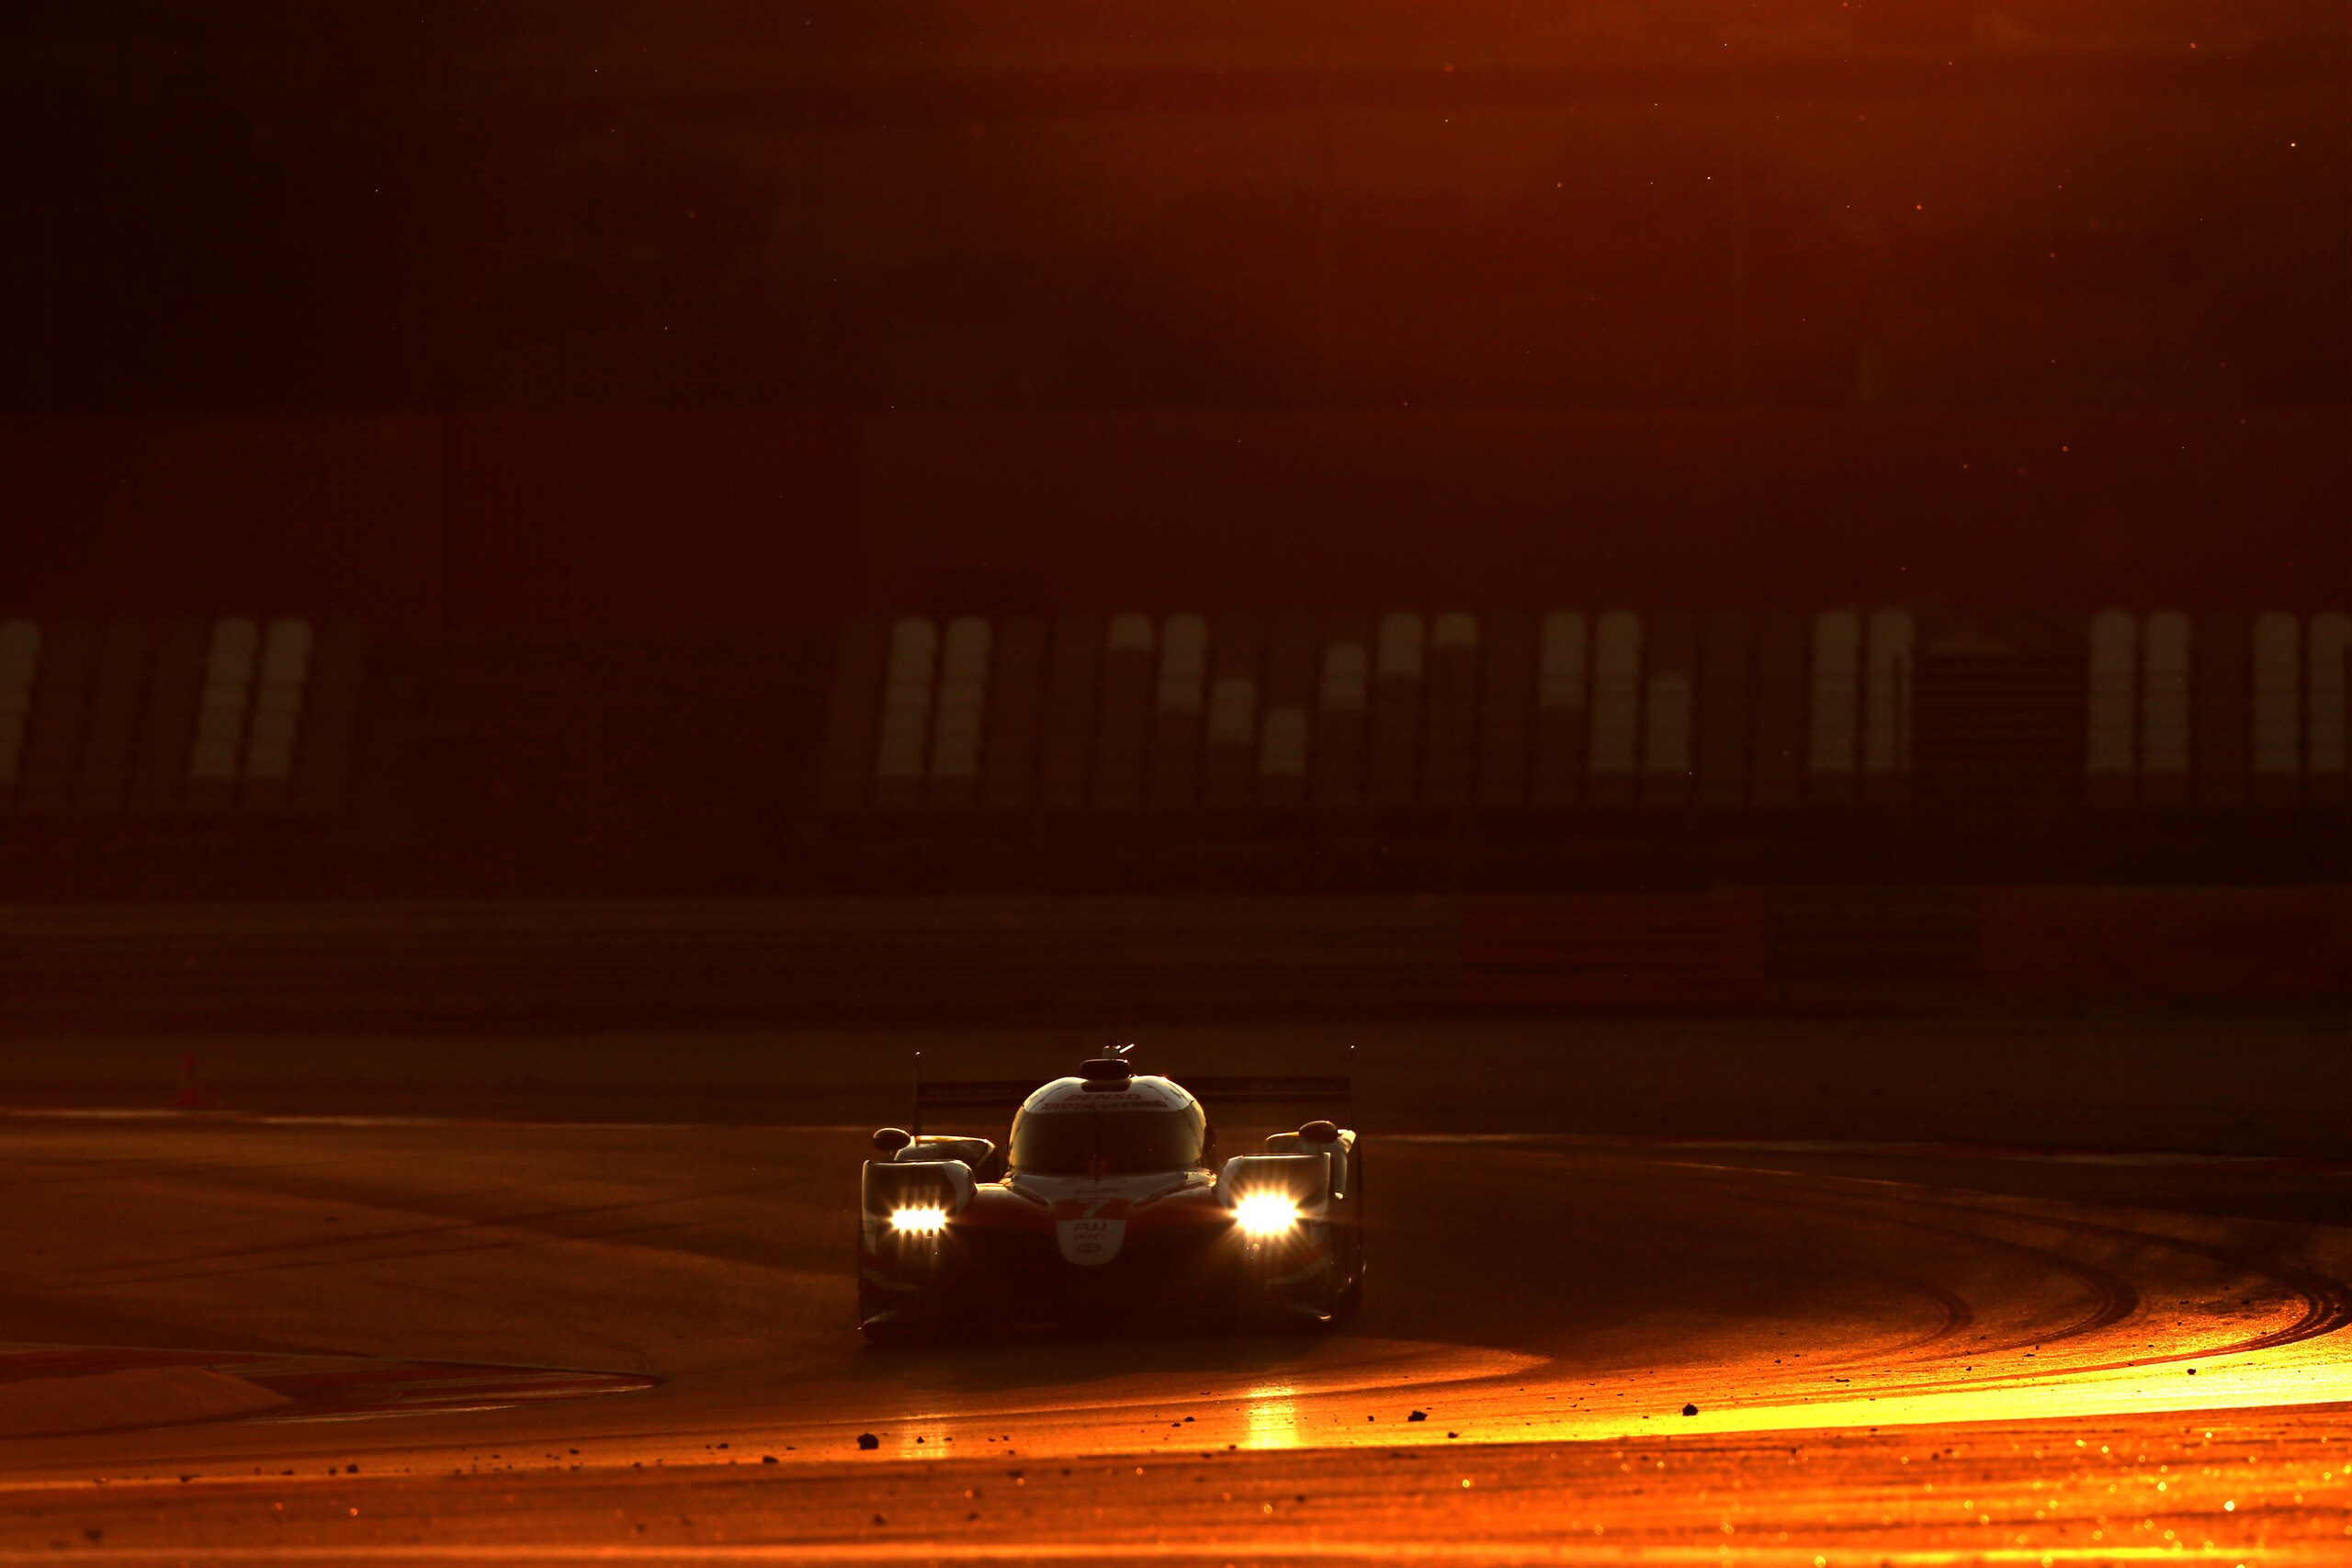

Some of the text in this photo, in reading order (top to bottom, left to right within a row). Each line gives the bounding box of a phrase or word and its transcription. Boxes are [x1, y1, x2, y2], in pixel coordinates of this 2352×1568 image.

[1064, 1093, 1141, 1101] DENSO
[1041, 1102, 1094, 1111] TOYOTA
[1076, 1198, 1111, 1219] 7
